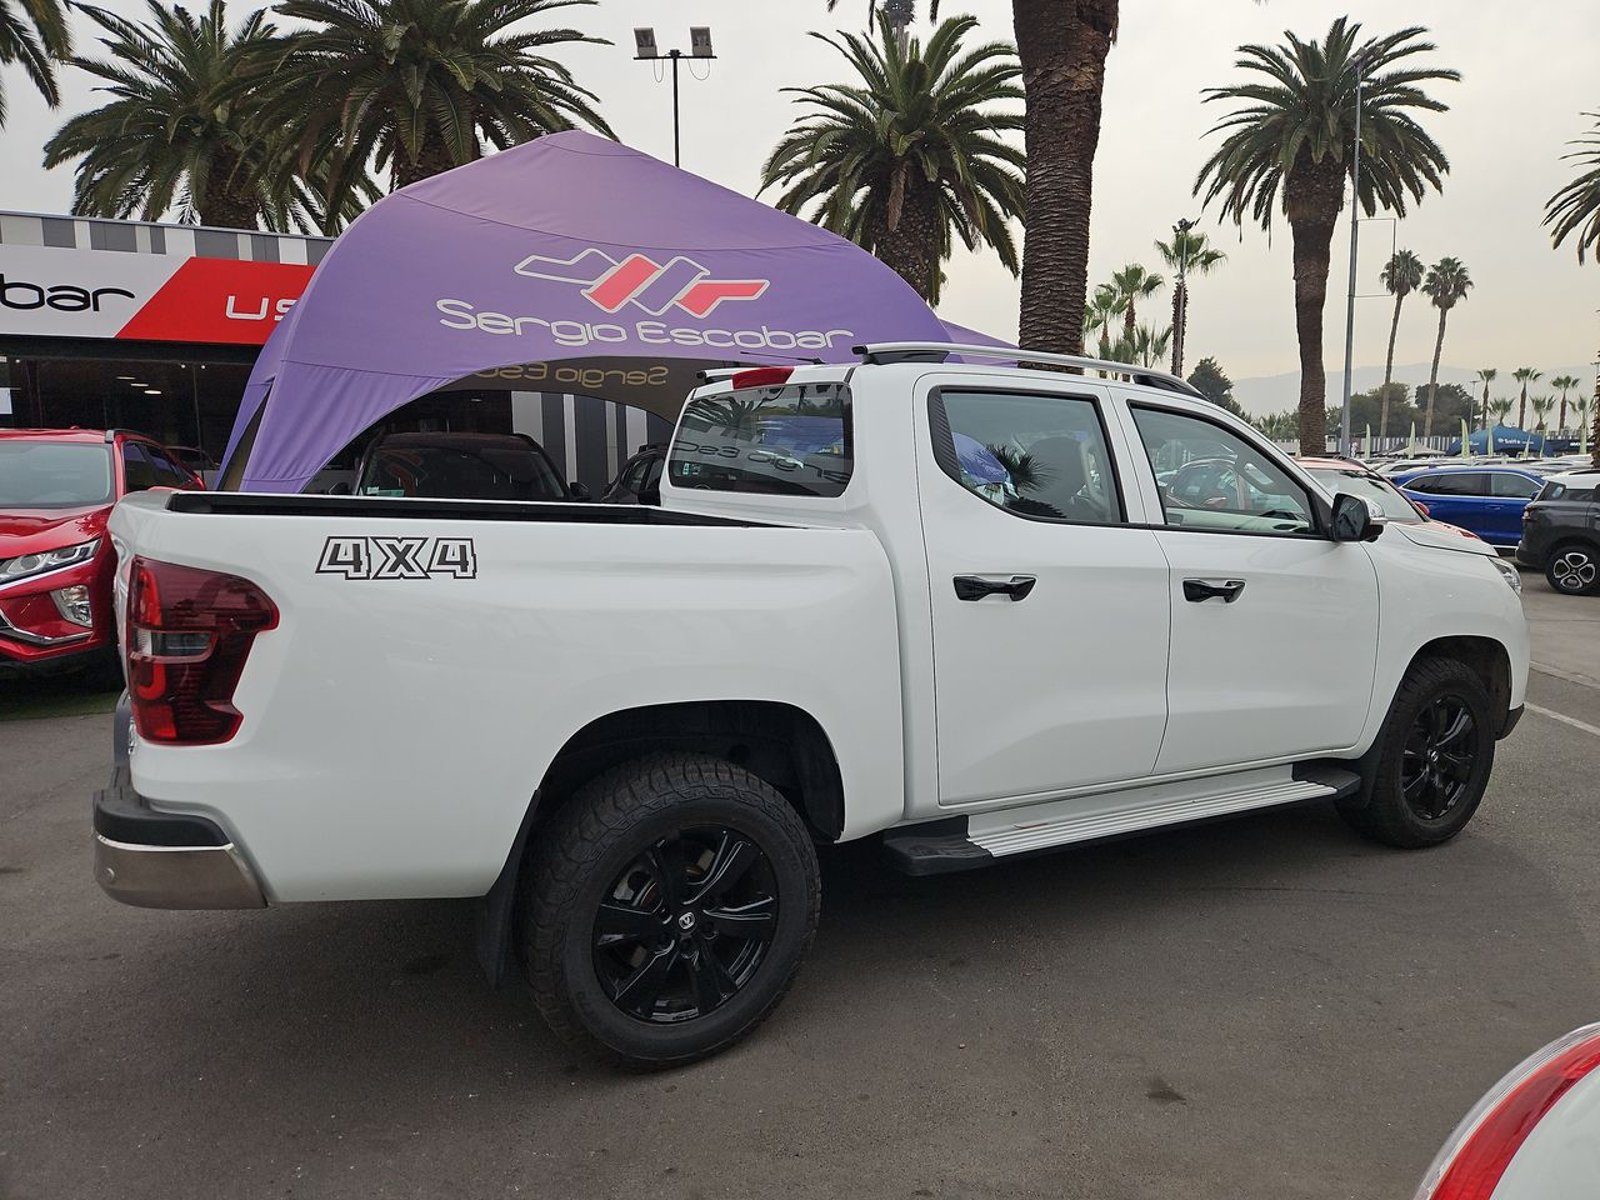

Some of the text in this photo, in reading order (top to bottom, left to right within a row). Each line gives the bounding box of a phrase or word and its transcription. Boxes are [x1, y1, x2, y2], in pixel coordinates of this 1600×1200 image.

[436, 299, 853, 349] Sergio Escobar
[315, 536, 477, 580] 4X4
